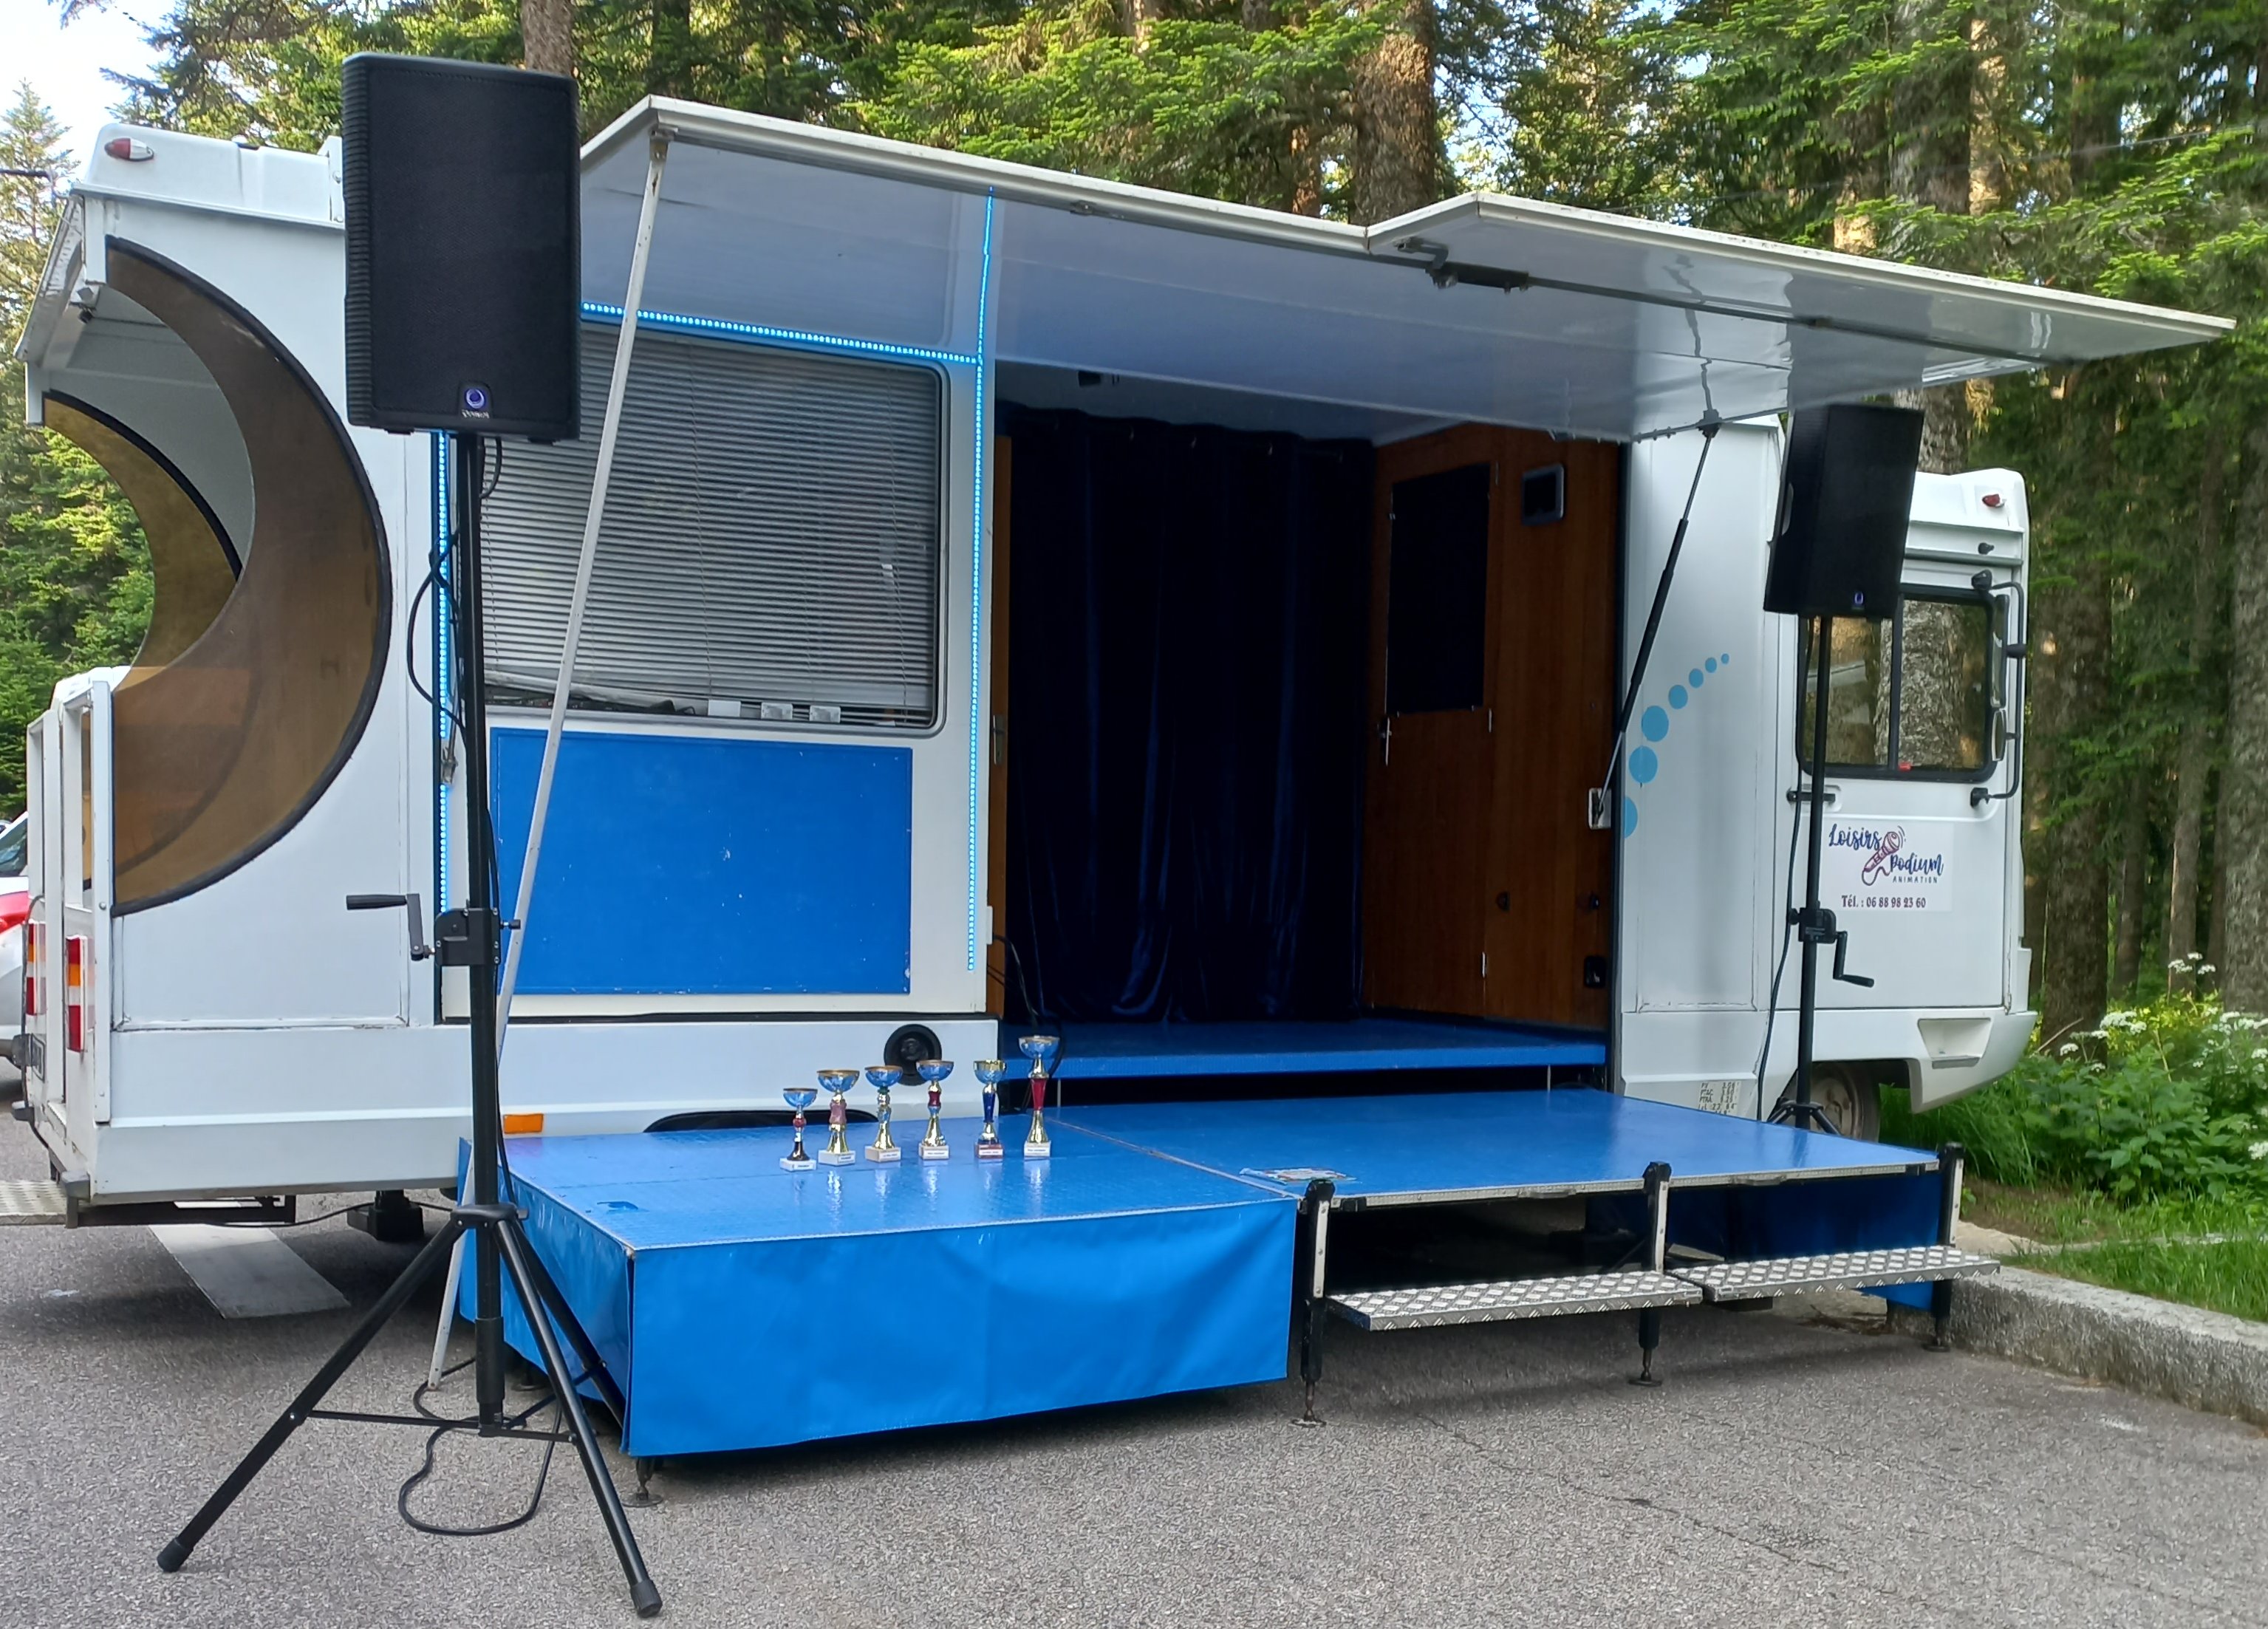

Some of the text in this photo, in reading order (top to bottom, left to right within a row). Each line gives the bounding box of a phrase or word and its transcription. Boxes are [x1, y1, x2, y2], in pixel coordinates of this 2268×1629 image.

[1828, 823, 1882, 851] Loisirs
[1890, 852, 1944, 877] Podium
[1892, 876, 1938, 884] ANIMATION
[1841, 894, 1859, 908] Tél.
[1866, 896, 1877, 908] 06
[1879, 896, 1889, 909] 88
[1890, 897, 1902, 909] 98
[1903, 897, 1914, 909] 23
[1916, 897, 1927, 909] 60
